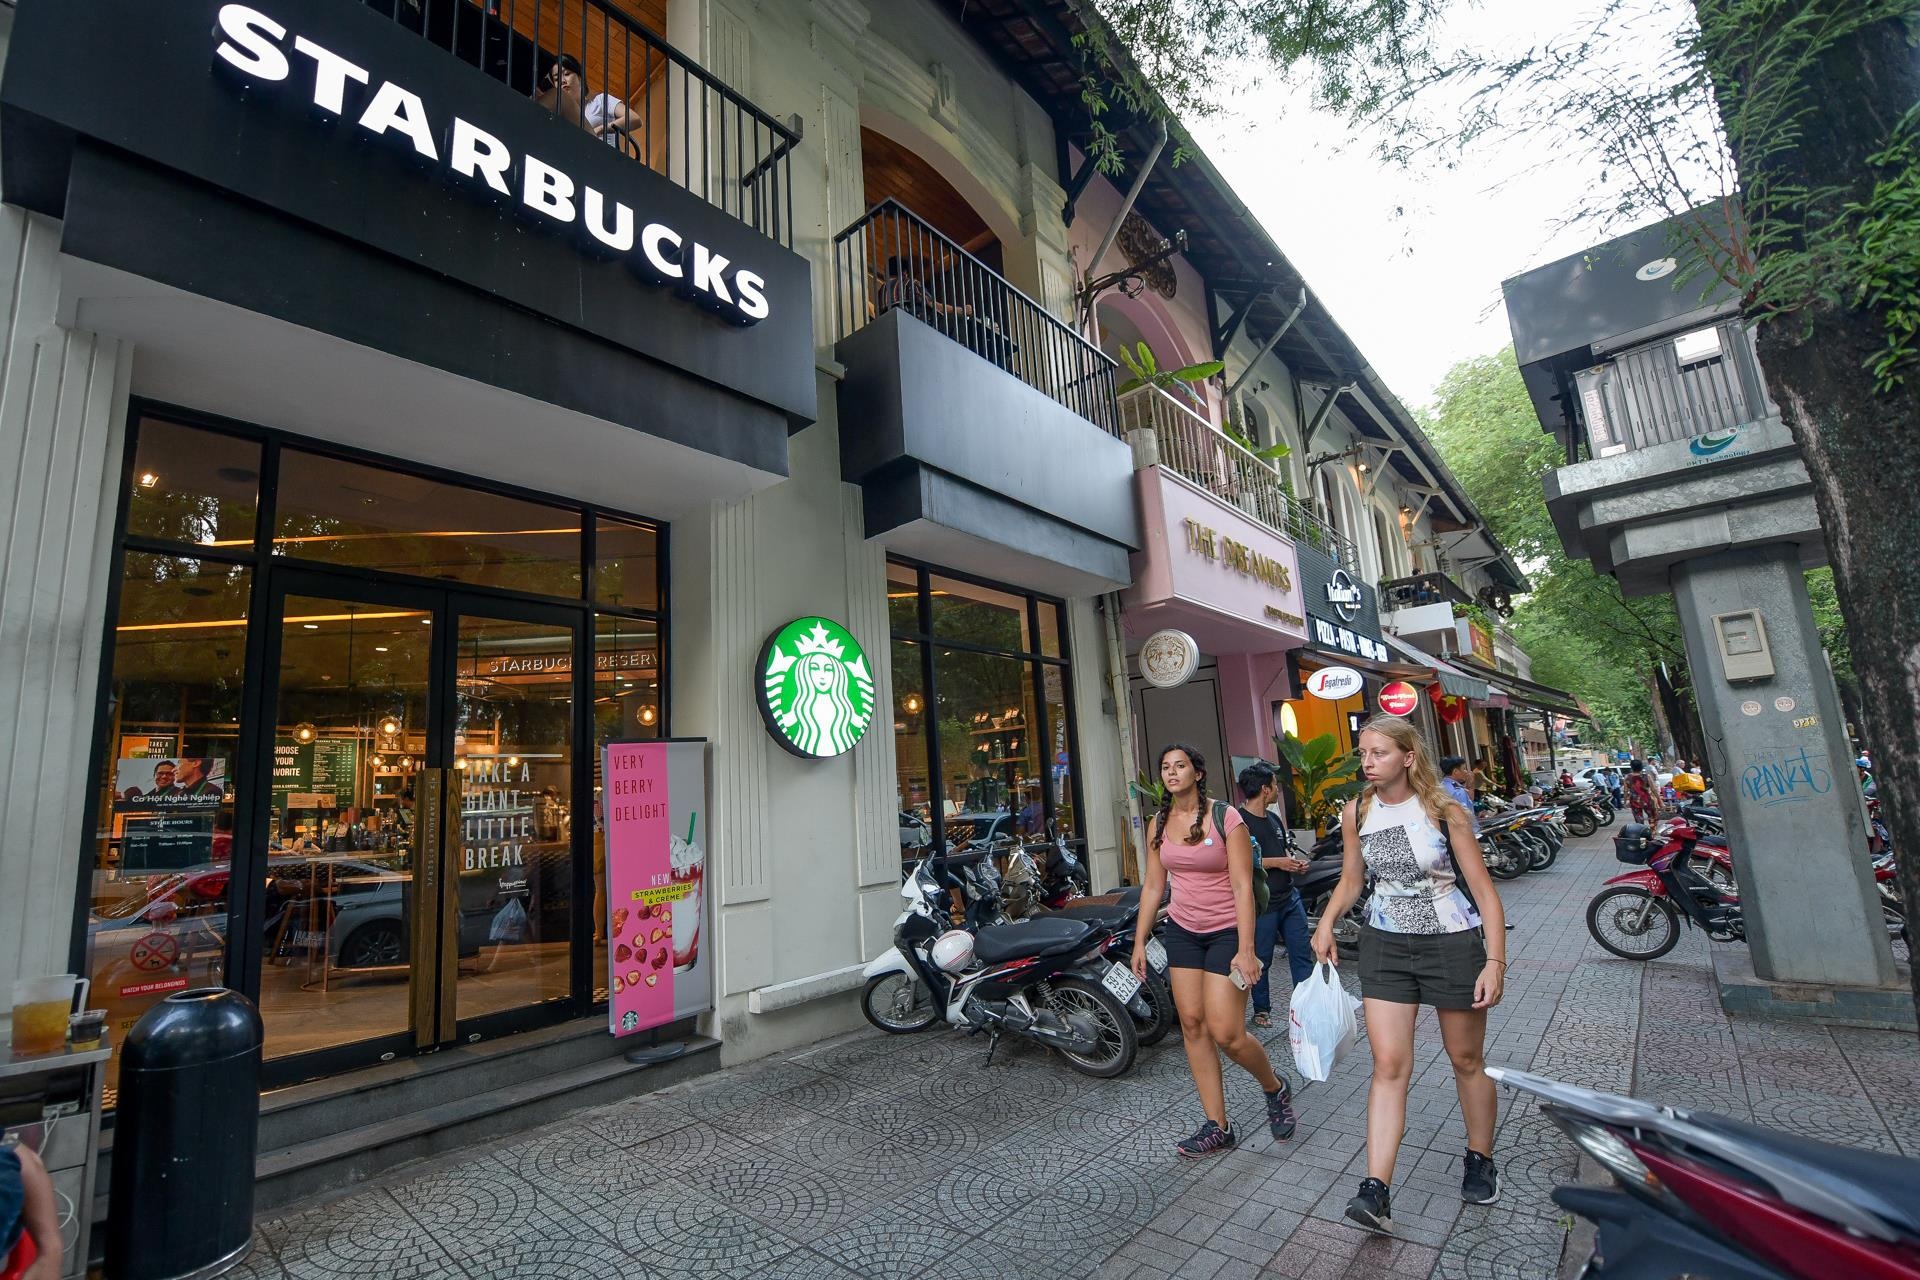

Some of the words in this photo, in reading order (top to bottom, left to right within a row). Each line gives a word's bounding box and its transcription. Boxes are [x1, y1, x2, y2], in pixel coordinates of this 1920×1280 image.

[216, 3, 770, 320] STARBUCKS
[1183, 517, 1219, 560] THE
[275, 757, 294, 766] YOUR
[614, 754, 645, 770] VERY
[467, 762, 512, 783] TAKE
[520, 761, 531, 782] A
[614, 778, 653, 795] BERRY
[466, 789, 520, 812] GIANT
[615, 803, 667, 822] DELIGHT
[466, 816, 529, 841] LITTLE
[465, 844, 523, 870] BREAK
[651, 873, 671, 886] NEW
[634, 883, 692, 899] STRAWBERRIES
[122, 986, 140, 994] WATCH
[154, 979, 186, 990] BELONGINGS
[1115, 974, 1138, 1001] 852.85
